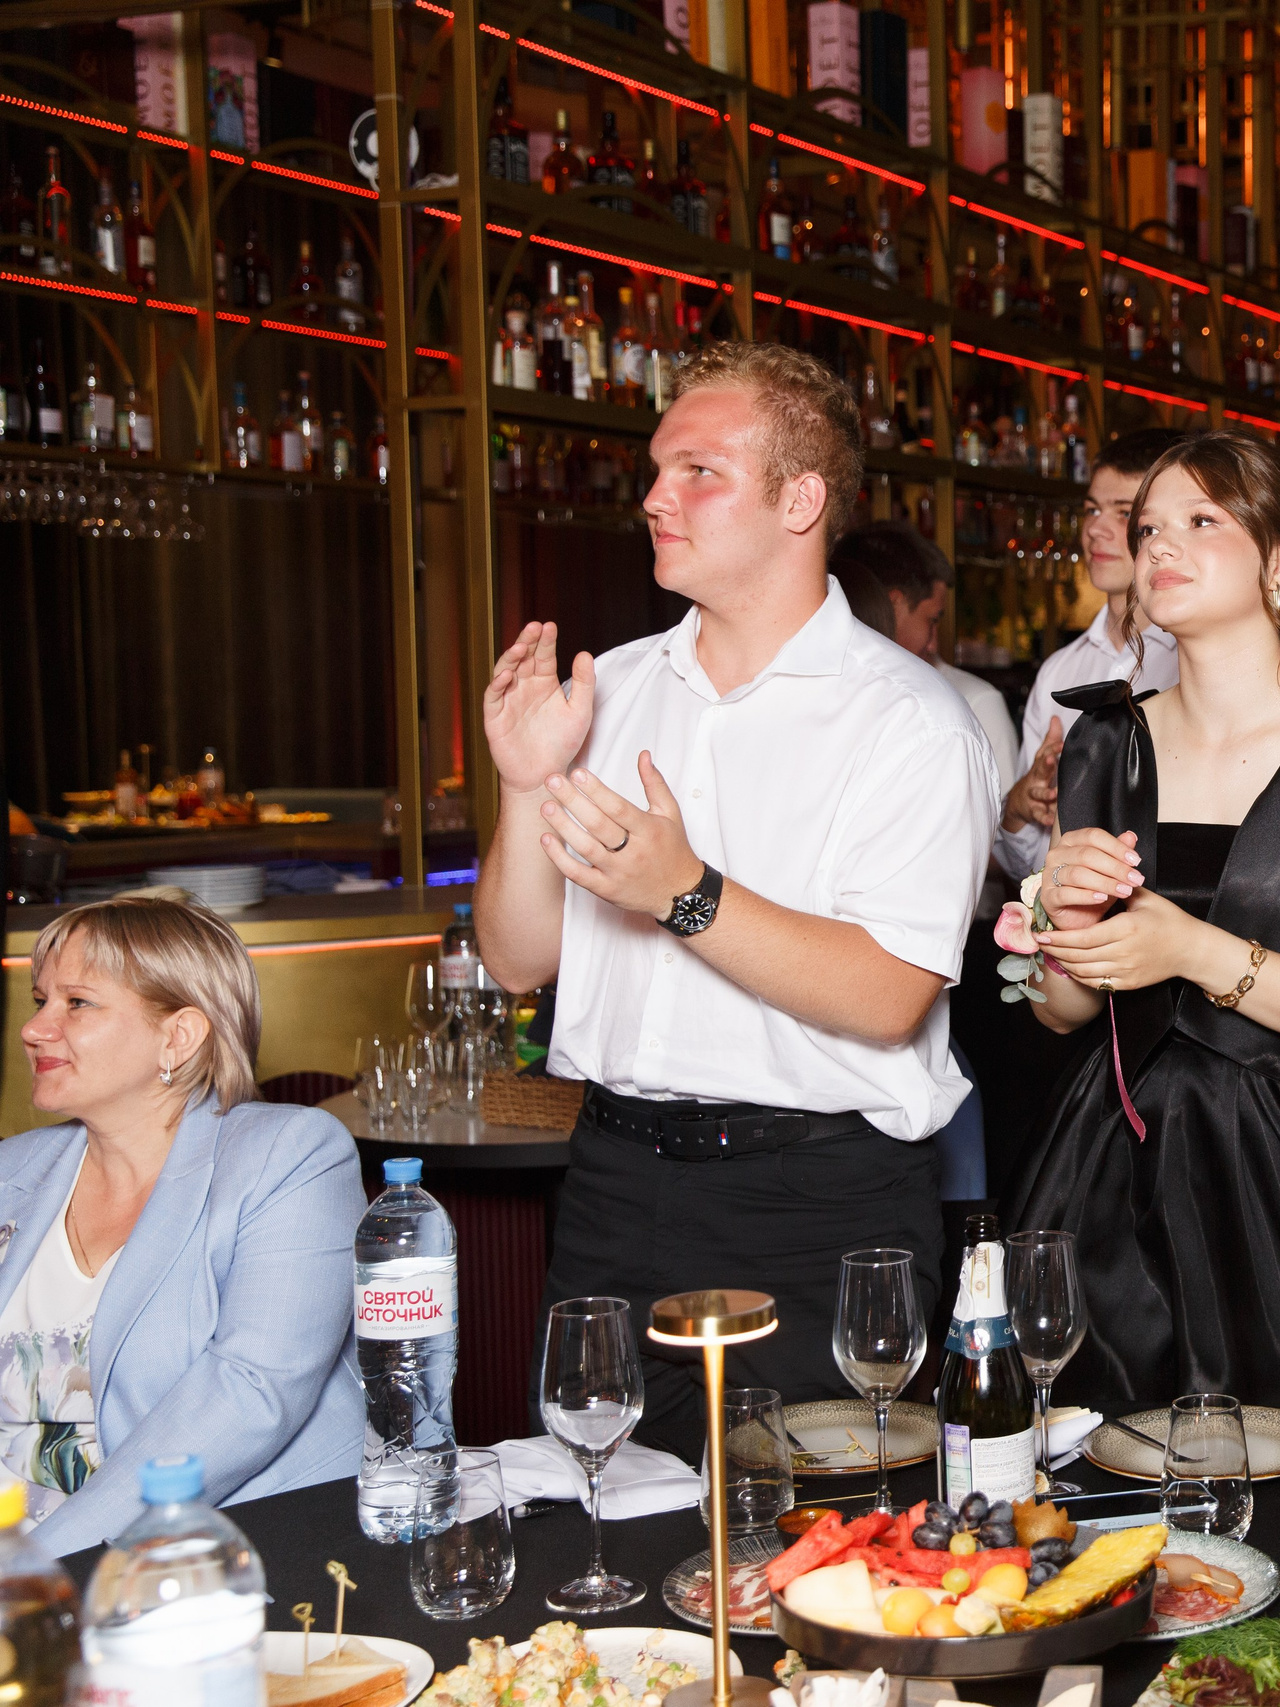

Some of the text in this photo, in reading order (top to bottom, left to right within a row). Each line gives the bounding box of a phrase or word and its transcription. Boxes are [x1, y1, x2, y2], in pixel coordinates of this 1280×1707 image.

[363, 1286, 434, 1305] СВЯТОЙ
[357, 1302, 444, 1322] ИСТОЧНИК
[371, 1323, 425, 1332] НЕГАЗИРОВАННАЯ
